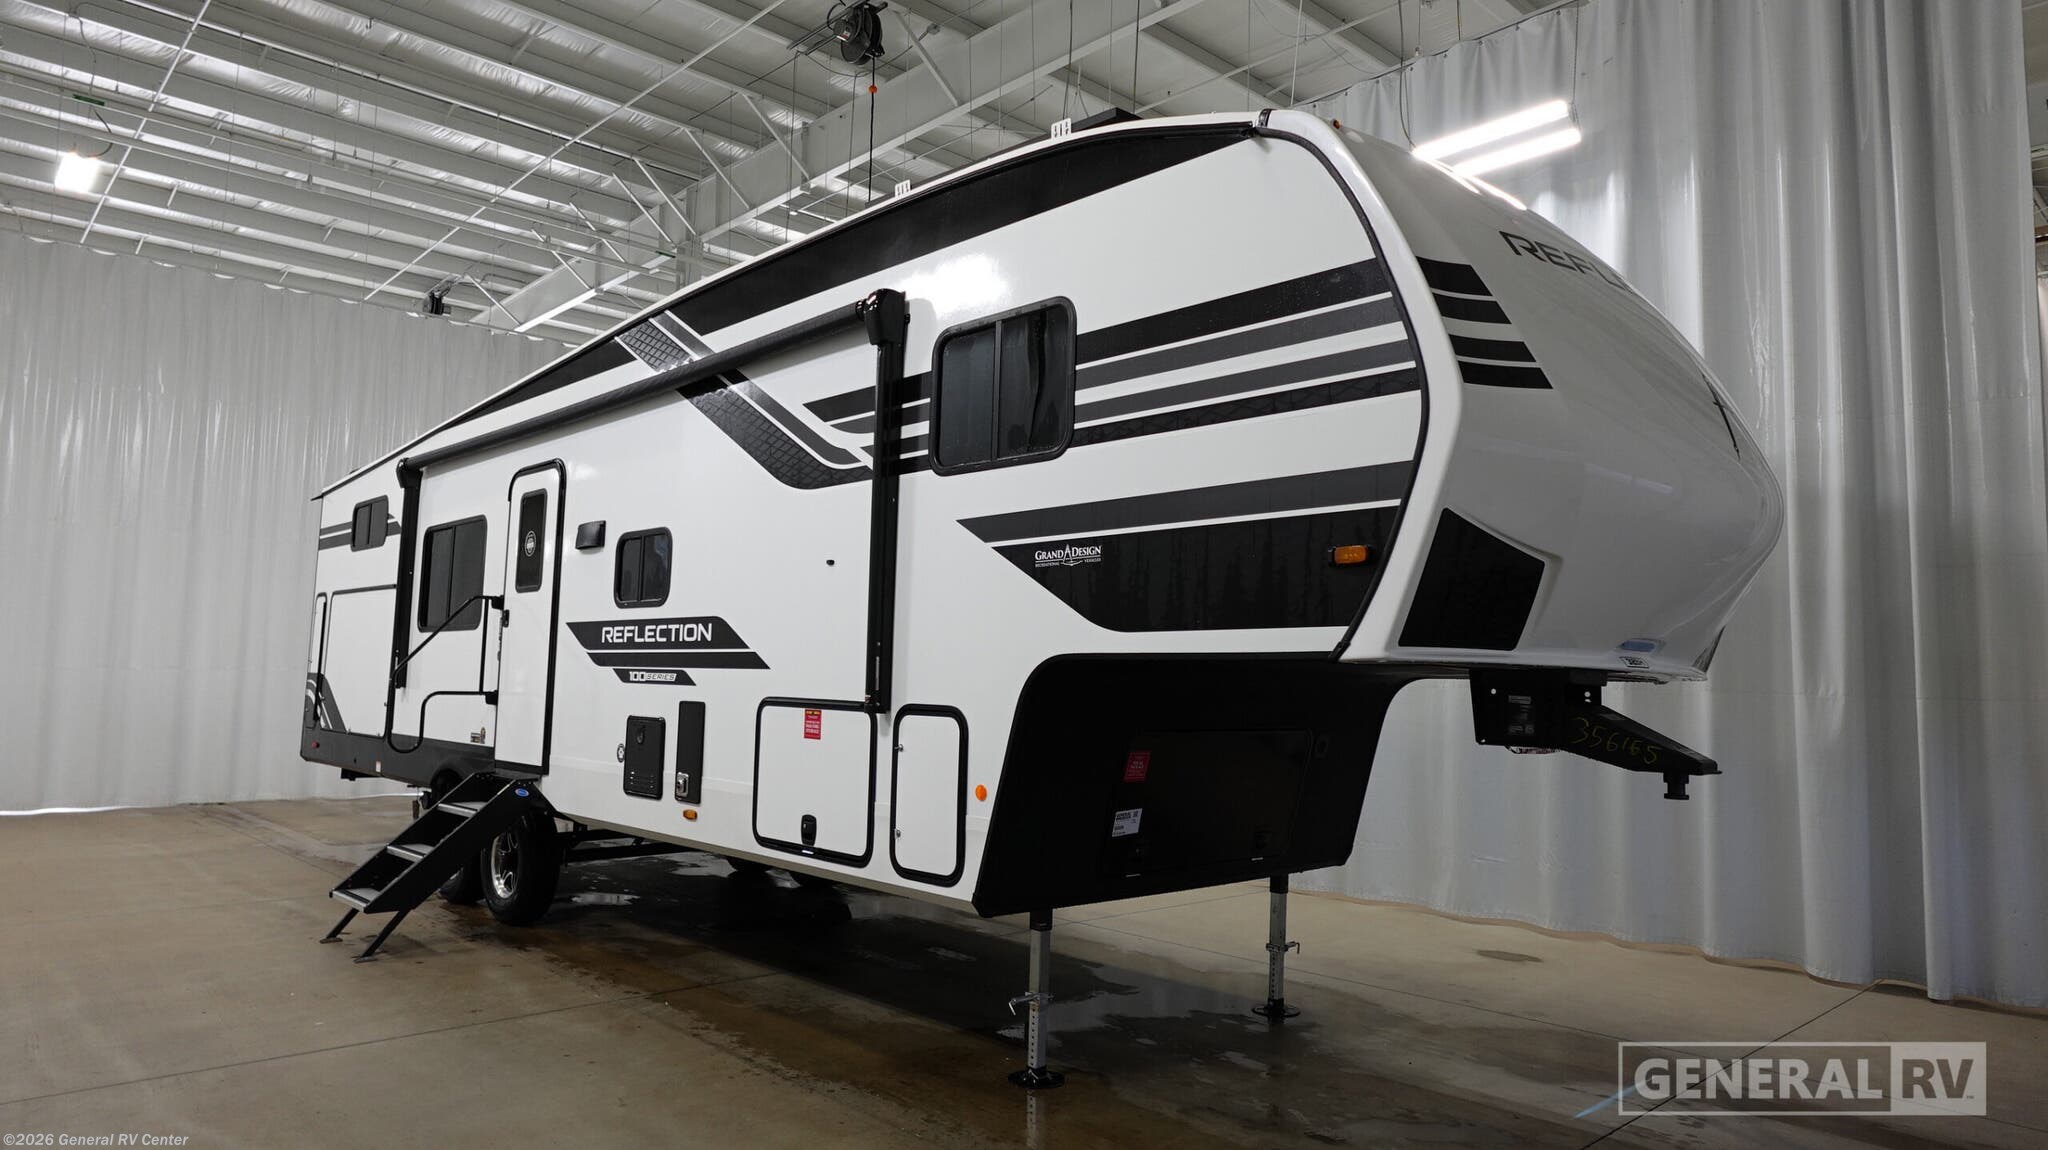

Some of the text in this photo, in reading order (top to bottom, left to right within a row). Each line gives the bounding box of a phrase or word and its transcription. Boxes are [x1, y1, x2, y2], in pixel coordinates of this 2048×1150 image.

[1035, 545, 1102, 560] GRAND DESIGN
[601, 622, 713, 644] REFLECTION
[629, 671, 676, 682] 100 SERIES
